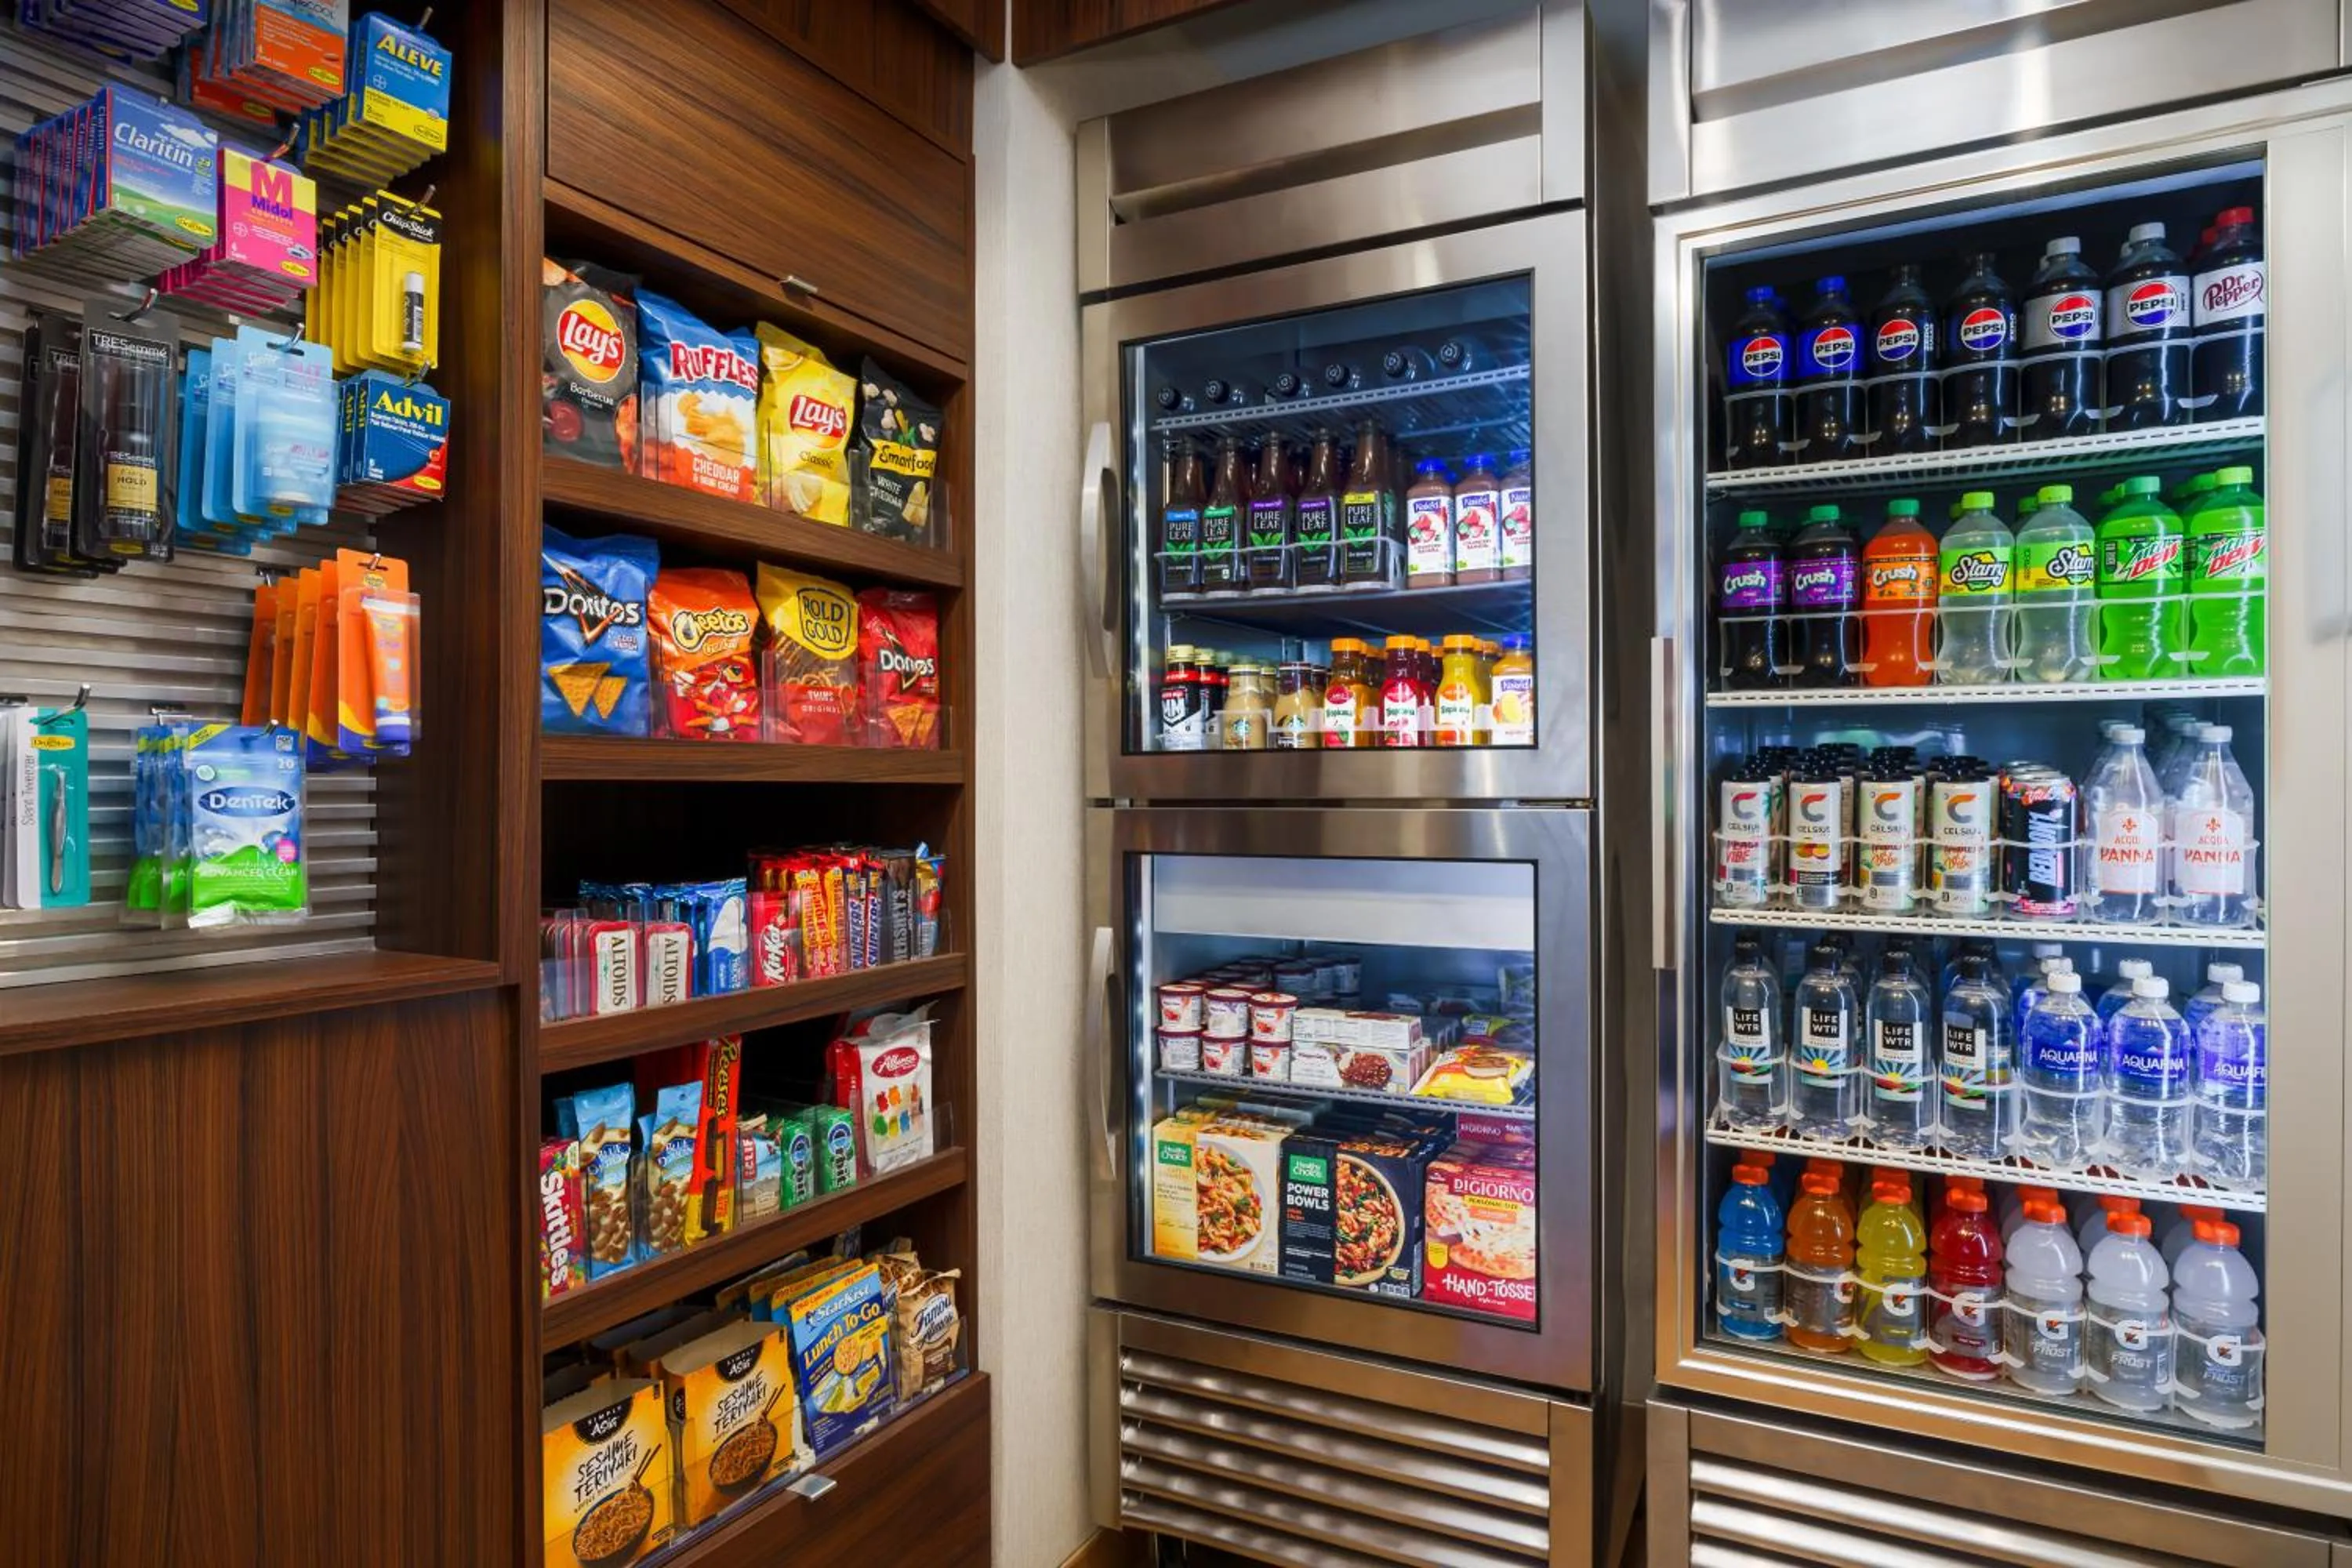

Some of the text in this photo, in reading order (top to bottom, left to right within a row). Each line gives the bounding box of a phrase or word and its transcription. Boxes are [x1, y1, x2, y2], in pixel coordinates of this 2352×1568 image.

[377, 34, 443, 77] ALEVE
[114, 122, 194, 168] Claritin
[251, 194, 293, 220] Midol
[382, 211, 434, 237] ChapStick
[2207, 277, 2261, 311] Pepper
[2220, 274, 2242, 294] Dr
[2052, 311, 2094, 324] PEPSI
[2129, 299, 2175, 314] PEPSI
[563, 313, 622, 365] Lay's
[1963, 322, 2005, 336] PEPSI
[92, 332, 168, 358] TRESemmé
[1815, 341, 1853, 354] PEPSI
[1879, 334, 1916, 347] PEPSI
[670, 341, 758, 393] RUFFLES
[1744, 351, 1780, 363] PEPSI
[570, 382, 614, 406] Barbecue
[372, 390, 443, 426] Advil
[792, 396, 844, 436] Lay's
[692, 457, 740, 485] CHEDDAR
[799, 450, 835, 470] Classic
[117, 475, 147, 487] HOLD
[877, 475, 902, 494] WHITE
[869, 485, 903, 510] CHEDDAR
[1254, 510, 1280, 521] PURE
[1302, 510, 1327, 521] PURE
[1348, 506, 1372, 515] PURE
[1348, 514, 1372, 524] LEAF
[1168, 521, 1195, 531] PURE
[1204, 517, 1230, 527] PURE
[1204, 527, 1229, 537] LEAF
[1254, 520, 1280, 530] LEAF
[1302, 521, 1328, 531] LEAF
[1168, 531, 1192, 540] LEAF
[1795, 568, 1835, 590] Crush
[1872, 564, 1916, 586] Crush
[1951, 554, 2006, 586] Starry
[1725, 570, 1766, 594] Crush
[543, 589, 641, 625] Doritos
[802, 595, 844, 622] ROLD
[673, 609, 748, 652] Cheetos
[804, 619, 843, 644] GOLD
[879, 648, 935, 676] Doritos
[801, 705, 841, 714] ORIGINAL
[209, 793, 290, 811] DenTek
[1797, 826, 1831, 834] CELSIUS
[2028, 811, 2056, 886] REDON1
[2100, 848, 2154, 863] PANNA
[2183, 848, 2241, 863] PANNA
[849, 902, 863, 970] SNICKERS
[867, 898, 880, 967] SNICKERS
[611, 936, 628, 1007] ALTOIDS
[662, 936, 679, 1005] ALTOIDS
[1734, 1013, 1759, 1022] LIFE
[1734, 1022, 1759, 1033] WTR
[1812, 1013, 1838, 1023] LIFE
[1812, 1024, 1838, 1034] WTR
[1884, 1025, 1911, 1036] LIFE
[1947, 1029, 1973, 1041] LIFE
[1884, 1036, 1913, 1047] WTR
[1947, 1040, 1973, 1052] WTR
[2039, 1047, 2098, 1065] AQUAFINA
[2122, 1054, 2184, 1071] AQUAFINA
[716, 1037, 739, 1119] Reese's
[2213, 1061, 2266, 1079] AQUAFI
[742, 1138, 755, 1167] CLIF
[1160, 1151, 1187, 1162] Choice
[1293, 1167, 1323, 1178] Choice
[1287, 1182, 1329, 1199] POWER
[1454, 1178, 1534, 1202] DIGIORNO
[1287, 1194, 1330, 1211] BOWLS
[540, 1171, 572, 1287] Skittles
[1730, 1258, 1755, 1291] G
[1443, 1272, 1535, 1302] HAND-TOSSE
[818, 1283, 870, 1320] StarKist
[1882, 1282, 1915, 1317] G
[1951, 1291, 1986, 1327] G
[911, 1294, 953, 1338] Famou
[2036, 1310, 2069, 1341] G
[804, 1323, 844, 1370] Lunch
[844, 1302, 880, 1332] To-Go
[2114, 1319, 2148, 1351] G
[2033, 1345, 2072, 1358] FROST
[2111, 1354, 2152, 1369] FROST
[2206, 1335, 2242, 1367] G
[717, 1370, 764, 1419] SESAME
[713, 1382, 768, 1434] TERIYAKI
[577, 1429, 635, 1483] SESAME
[574, 1443, 638, 1503] TERIYAKI
